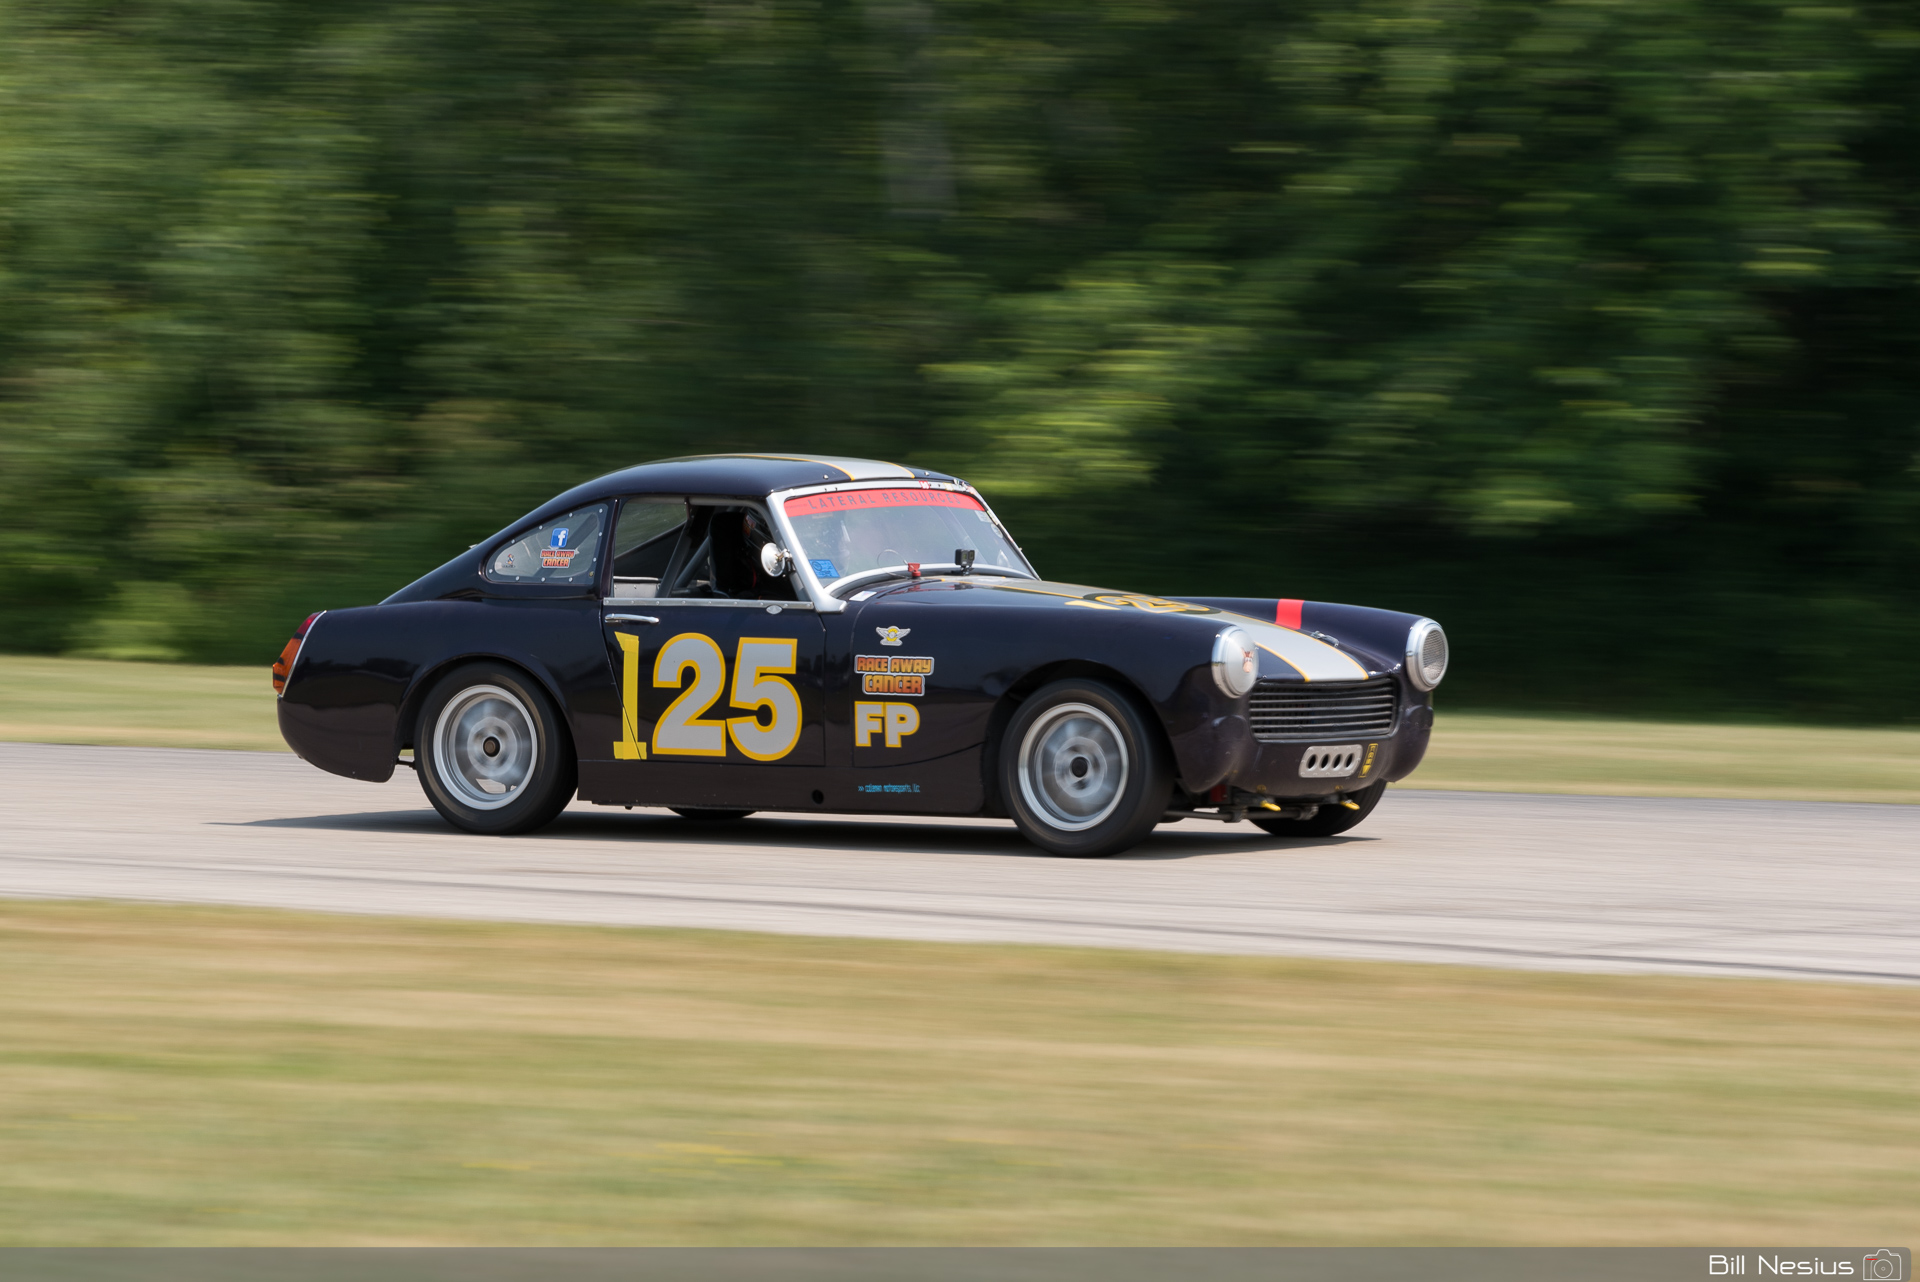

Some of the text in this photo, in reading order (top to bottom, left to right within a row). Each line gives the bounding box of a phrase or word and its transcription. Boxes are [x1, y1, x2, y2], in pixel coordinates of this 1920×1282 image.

[807, 492, 961, 510] LATERAL RESOURCES
[543, 558, 569, 567] CANCER
[857, 657, 932, 674] RACE AWAY
[864, 674, 923, 694] CANCER
[613, 631, 803, 762] 125
[854, 701, 921, 748] FP
